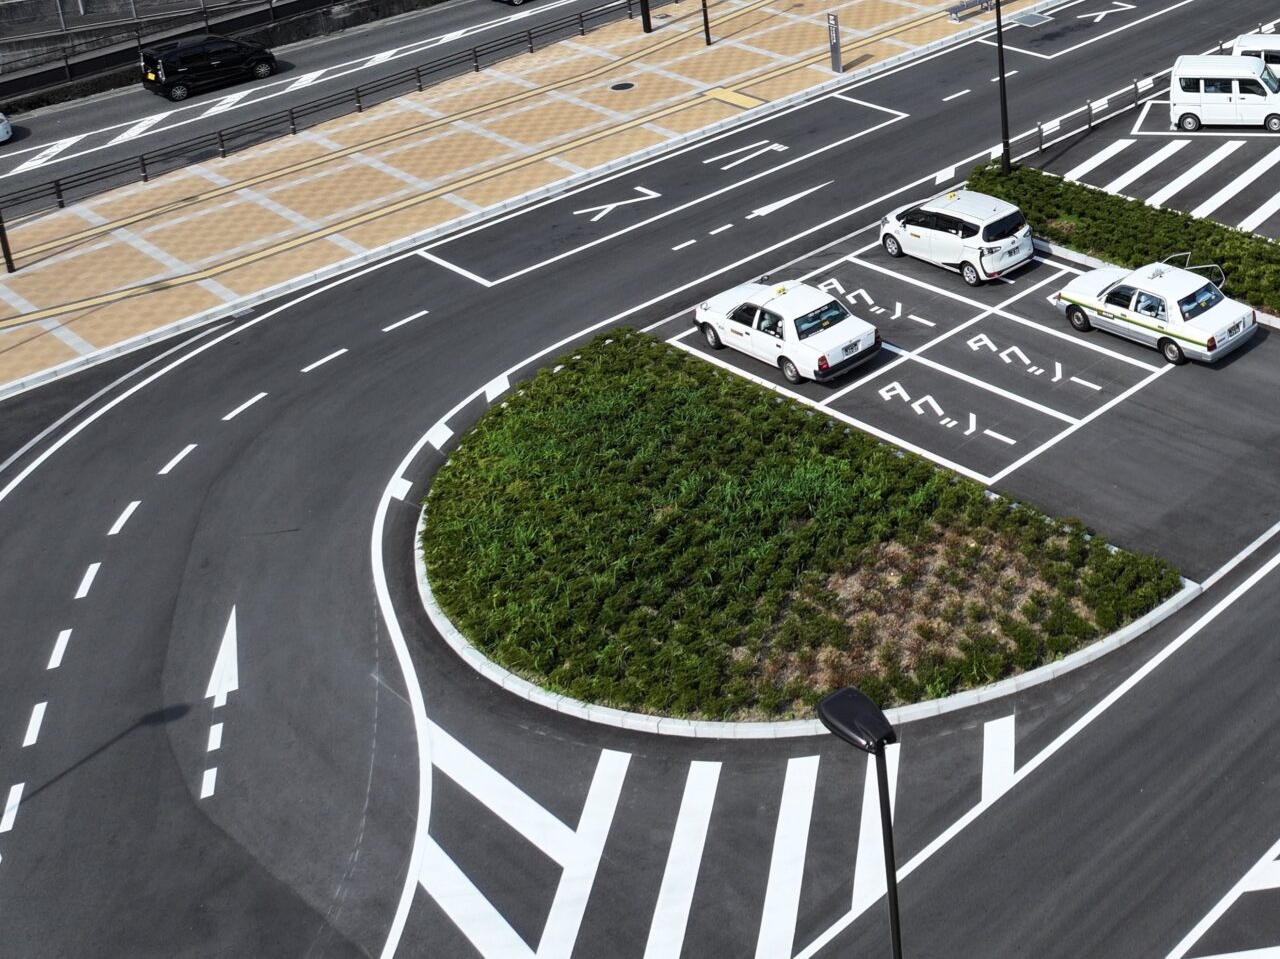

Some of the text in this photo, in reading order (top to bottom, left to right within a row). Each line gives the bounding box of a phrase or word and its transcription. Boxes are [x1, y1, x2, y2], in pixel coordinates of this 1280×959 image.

[572, 140, 790, 222] バス
[817, 277, 937, 327] タクシー
[966, 333, 1103, 391] タクシー
[878, 381, 1017, 445] タクシー
